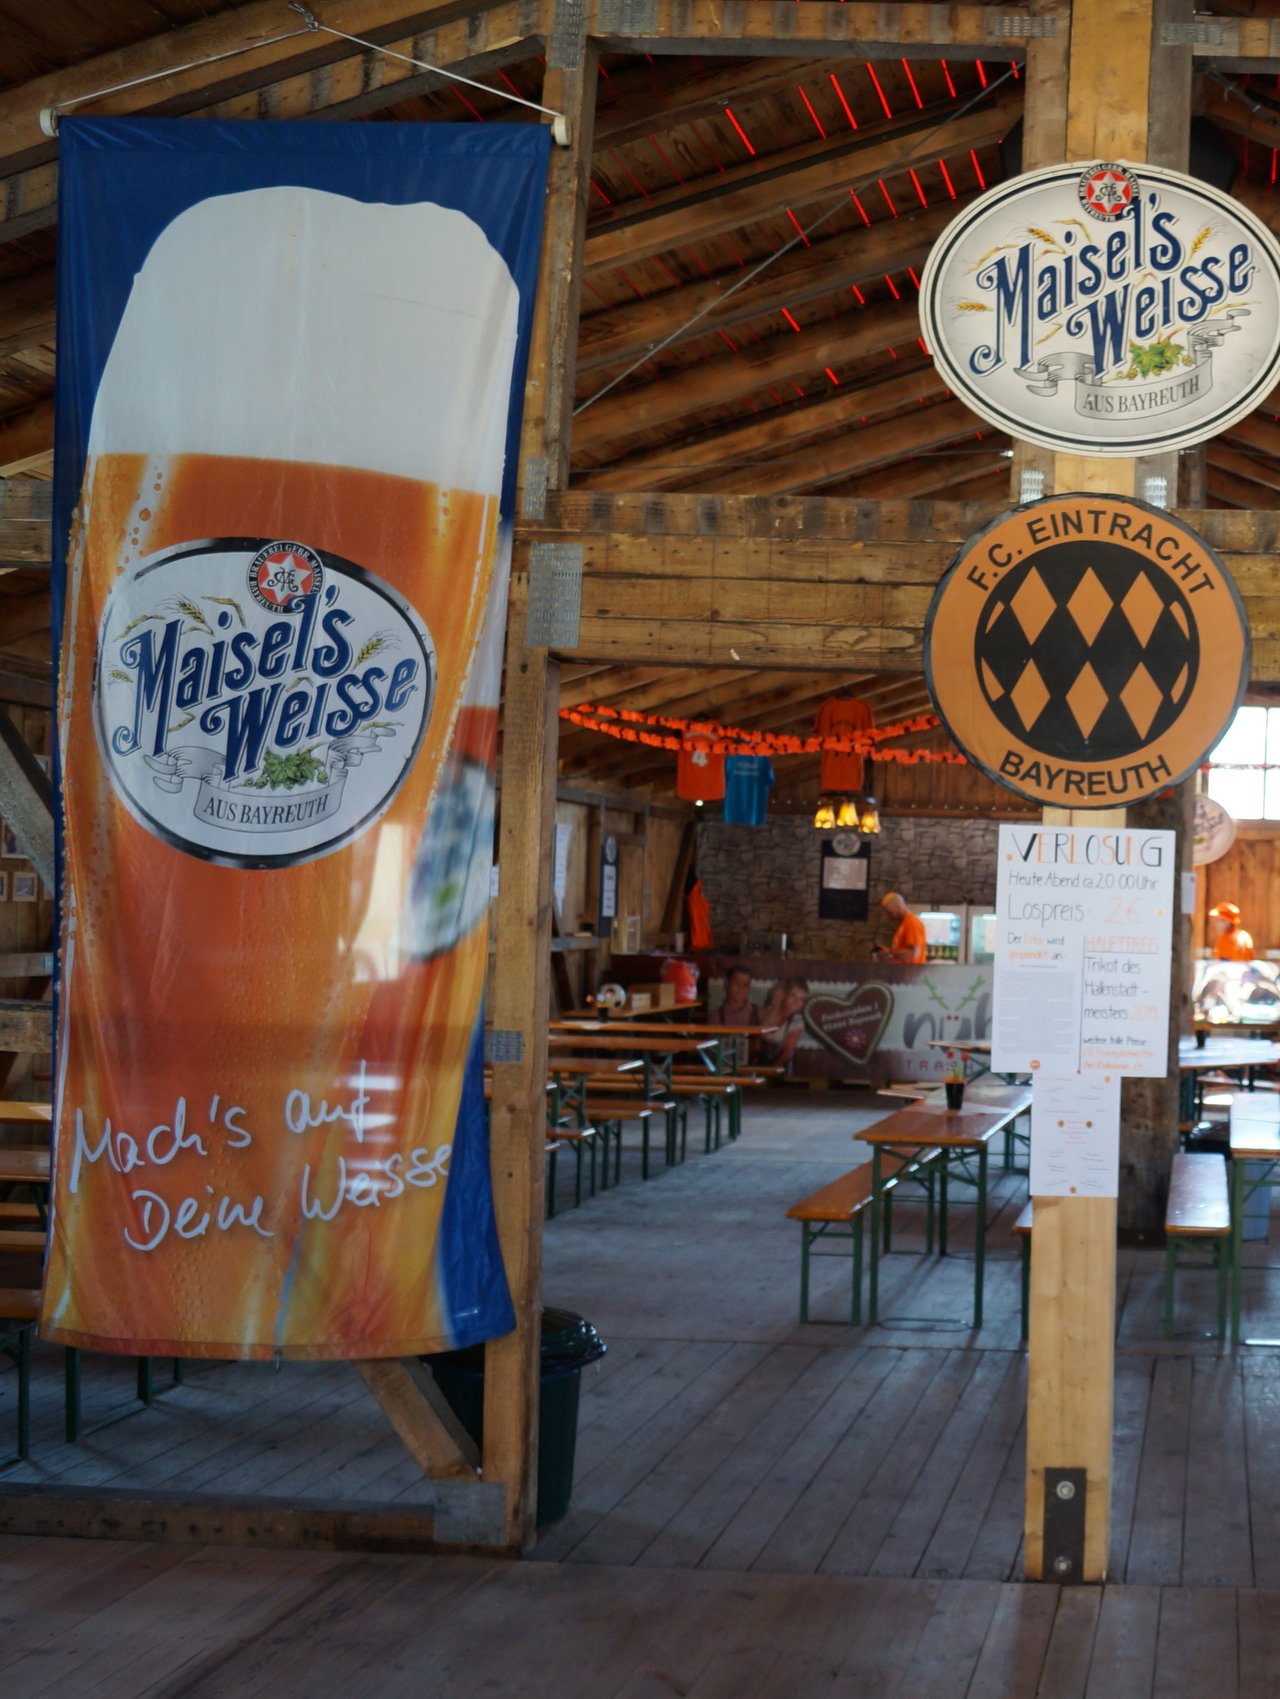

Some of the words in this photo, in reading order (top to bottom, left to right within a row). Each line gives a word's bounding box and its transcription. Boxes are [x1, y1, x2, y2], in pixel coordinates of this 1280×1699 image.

[968, 192, 1184, 377] Maisel's
[1066, 242, 1261, 378] Weisse
[1082, 389, 1114, 415] AUS
[1118, 373, 1200, 414] BAYREUTH
[966, 542, 1023, 592] F.C.
[1026, 509, 1215, 595] EINTRACHT
[112, 585, 354, 758] Maisel's
[199, 657, 419, 784] Weisse
[203, 795, 237, 821] AUS
[240, 794, 329, 826] BAYREUTH
[999, 750, 1173, 797] BAYREUTH
[1008, 869, 1042, 888] Heute
[1044, 870, 1081, 888] Abend
[1083, 956, 1119, 974] Trikot
[1121, 958, 1141, 975] des
[69, 1093, 253, 1194] Mach's
[284, 1058, 371, 1143] auf
[124, 1184, 276, 1252] Deine
